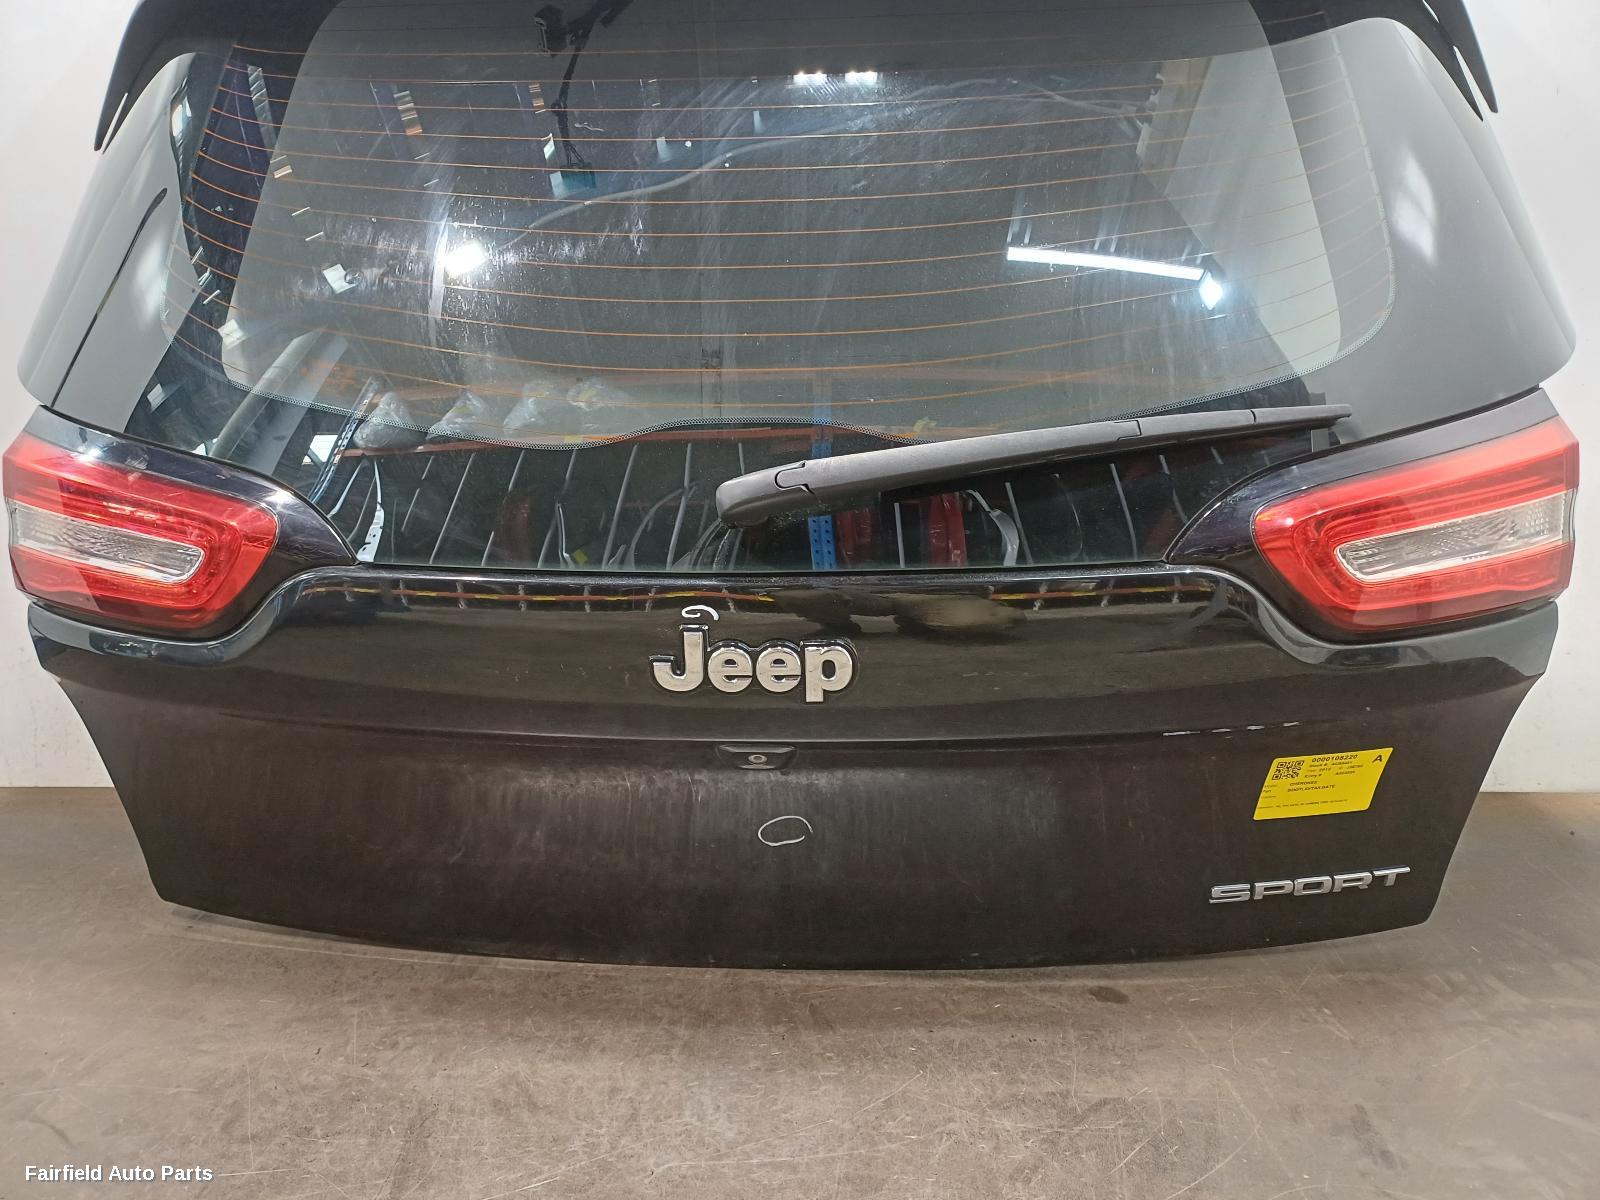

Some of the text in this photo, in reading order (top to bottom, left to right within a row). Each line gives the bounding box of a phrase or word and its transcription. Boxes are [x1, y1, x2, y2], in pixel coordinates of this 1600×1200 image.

[650, 624, 858, 703] Jeep
[1372, 754, 1383, 763] A
[1209, 865, 1411, 904] SPORT
